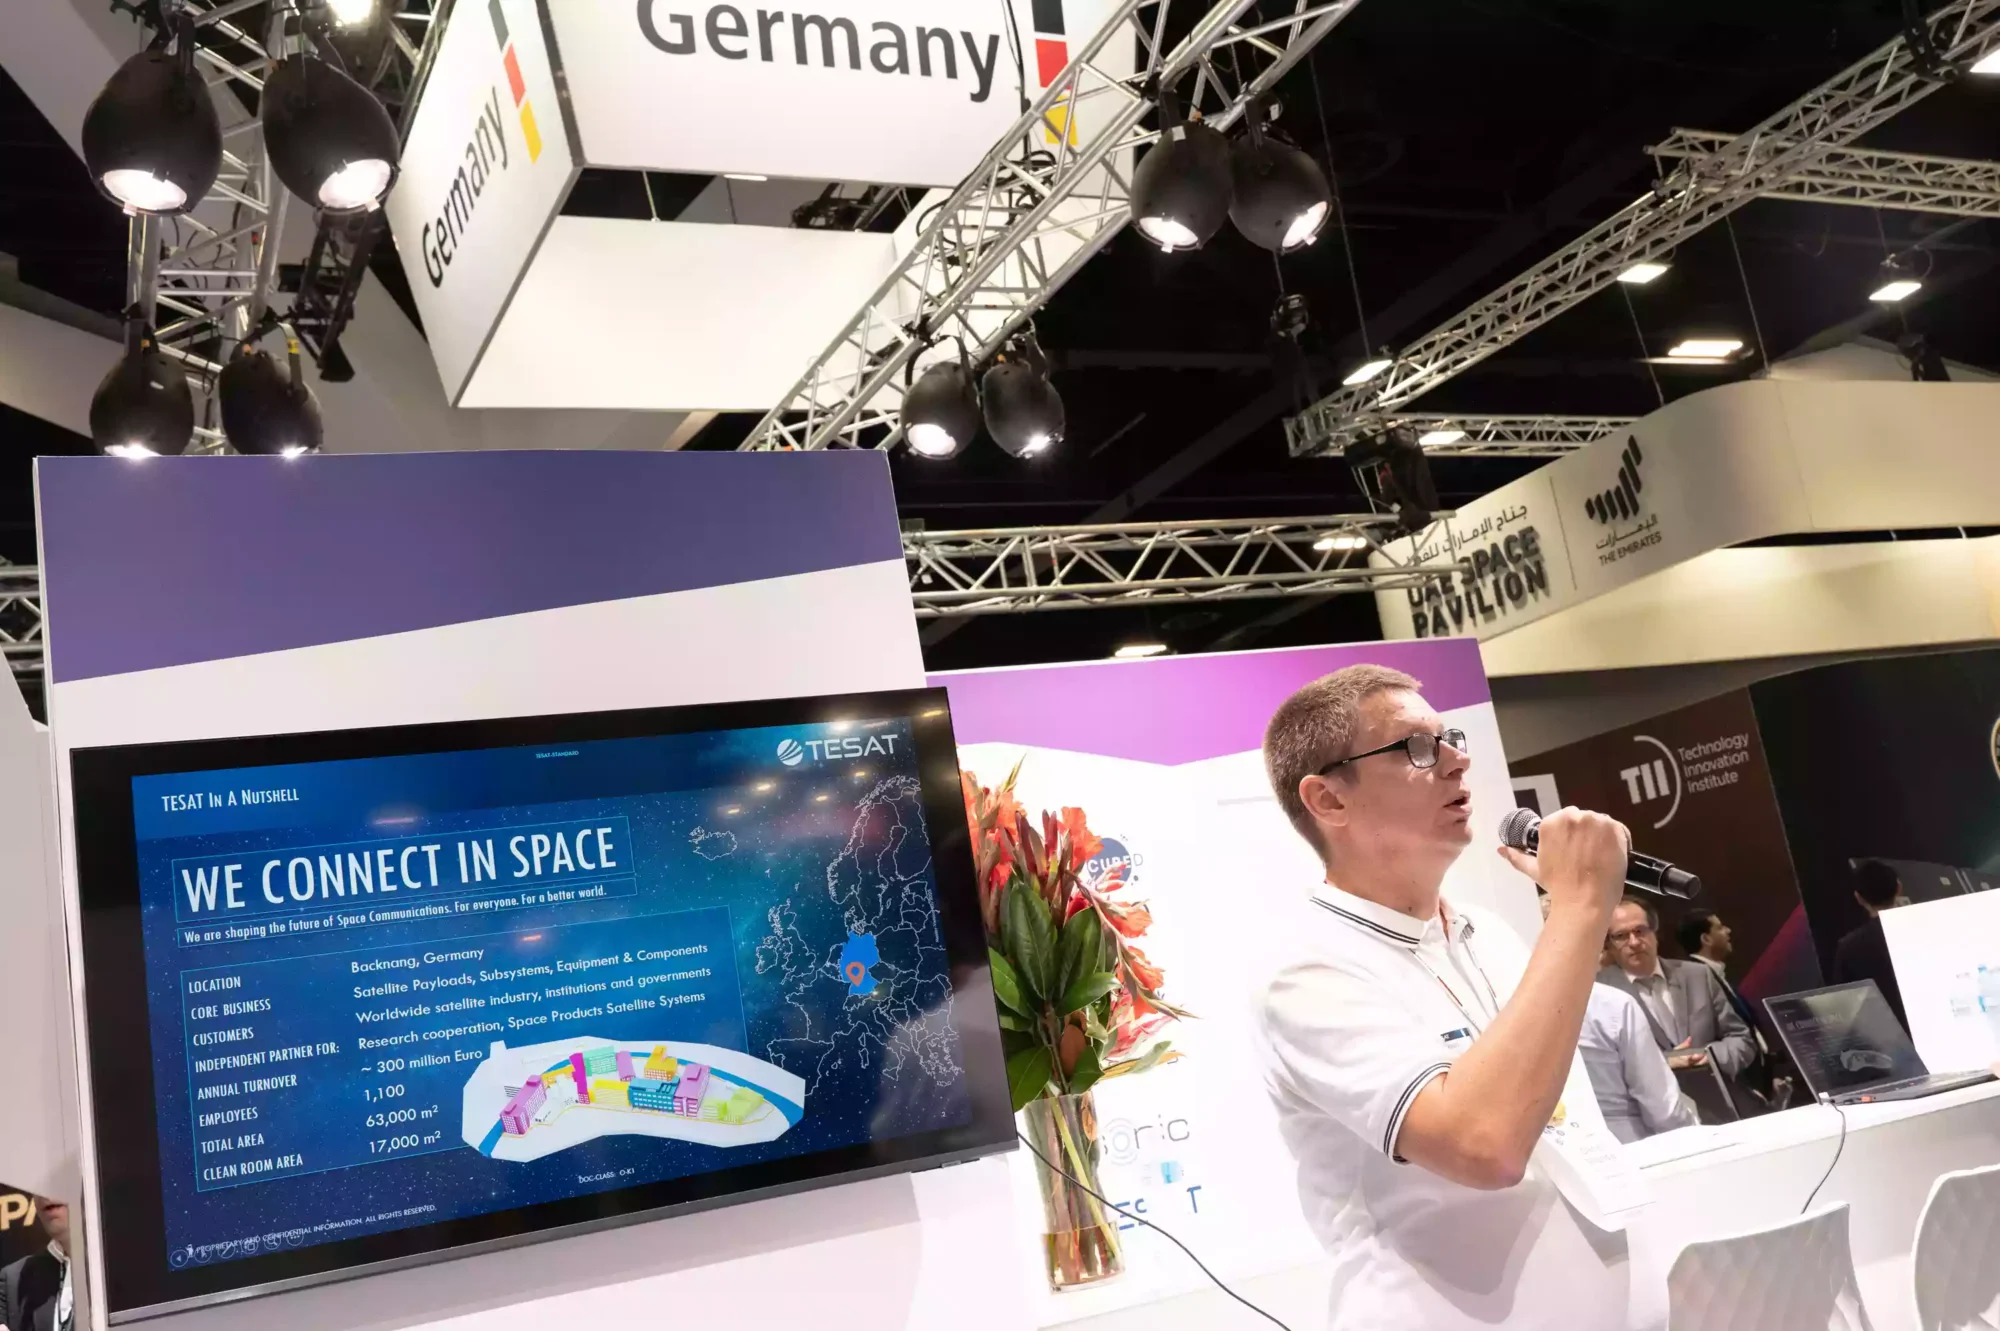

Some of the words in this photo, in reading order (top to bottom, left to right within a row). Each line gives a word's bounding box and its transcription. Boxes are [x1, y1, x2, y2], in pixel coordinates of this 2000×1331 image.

[637, 0, 1000, 102] Germany
[422, 85, 508, 288] Germany
[1496, 505, 1528, 532] جناح
[1459, 526, 1540, 585] SPACE
[1598, 550, 1617, 566] THE
[1617, 531, 1663, 559] EMIRATES
[1412, 561, 1547, 637] PAVILION
[805, 734, 898, 761] TESAT
[1678, 733, 1749, 761] Technology
[1620, 759, 1670, 804] TII
[1684, 751, 1749, 777] Innovation
[1687, 772, 1739, 793] Institute
[161, 793, 203, 812] TESAT
[228, 790, 237, 806] A
[182, 864, 246, 913] WE
[262, 844, 441, 904] CONNECT
[457, 839, 497, 883] IN
[509, 827, 617, 878] SPACE
[184, 931, 201, 944] We
[204, 930, 221, 941] are
[225, 925, 266, 940] shaping
[269, 921, 286, 934] the
[288, 917, 320, 932] future
[323, 916, 334, 927] of
[337, 912, 366, 928] Space
[369, 902, 452, 922] Communications.
[455, 901, 470, 913] For
[473, 897, 518, 911] everyone.
[521, 893, 536, 904] For
[539, 895, 545, 903] a
[547, 889, 575, 902] better
[578, 885, 607, 898] world.
[351, 957, 420, 973] Backnang,
[423, 949, 484, 964] Germany
[354, 983, 409, 999] Satellite
[413, 973, 476, 992] Payloads,
[480, 965, 554, 982] Subsystems,
[556, 954, 619, 973] Equipment
[623, 952, 633, 963] &
[637, 944, 708, 962] Components
[188, 976, 242, 994] LOCATION
[356, 1004, 431, 1024] Worldwide
[435, 997, 486, 1014] satellite
[490, 991, 542, 1006] industry,
[545, 982, 607, 999] institutions
[611, 976, 634, 990] and
[638, 967, 711, 988] governments
[191, 1005, 219, 1020] CORE
[223, 999, 271, 1016] BUSINESS
[358, 1030, 419, 1050] Research
[422, 1020, 504, 1041] cooperation,
[507, 1014, 547, 1030] Space
[552, 1006, 603, 1022] Products
[606, 998, 656, 1014] Satellite
[659, 992, 705, 1008] Systems
[193, 1027, 255, 1046] CUSTOMERS
[195, 1051, 266, 1073] INDEPENDENT
[269, 1045, 313, 1062] PARTNER
[317, 1042, 340, 1055] FOR:
[377, 1059, 405, 1074] 300
[409, 1053, 451, 1069] million
[455, 1049, 483, 1062] Euro
[197, 1083, 240, 1101] ANNUAL
[243, 1074, 298, 1093] TURNOVER
[364, 1084, 405, 1103] 1,100
[199, 1106, 259, 1127] EMPLOYEES
[366, 1108, 417, 1128] 63,000
[201, 1138, 234, 1154] TOTAL
[237, 1133, 265, 1148] AREA
[369, 1134, 419, 1154] 17,000
[203, 1164, 237, 1181] CLEAN
[241, 1158, 273, 1175] ROOM
[276, 1153, 303, 1169] AREA
[196, 1239, 242, 1253] PROPRIETARY
[262, 1227, 312, 1242] CONFIDENTIAL
[365, 1214, 377, 1223] ALL
[378, 1210, 402, 1221] RIGHTS
[403, 1204, 437, 1216] RESERVED.
